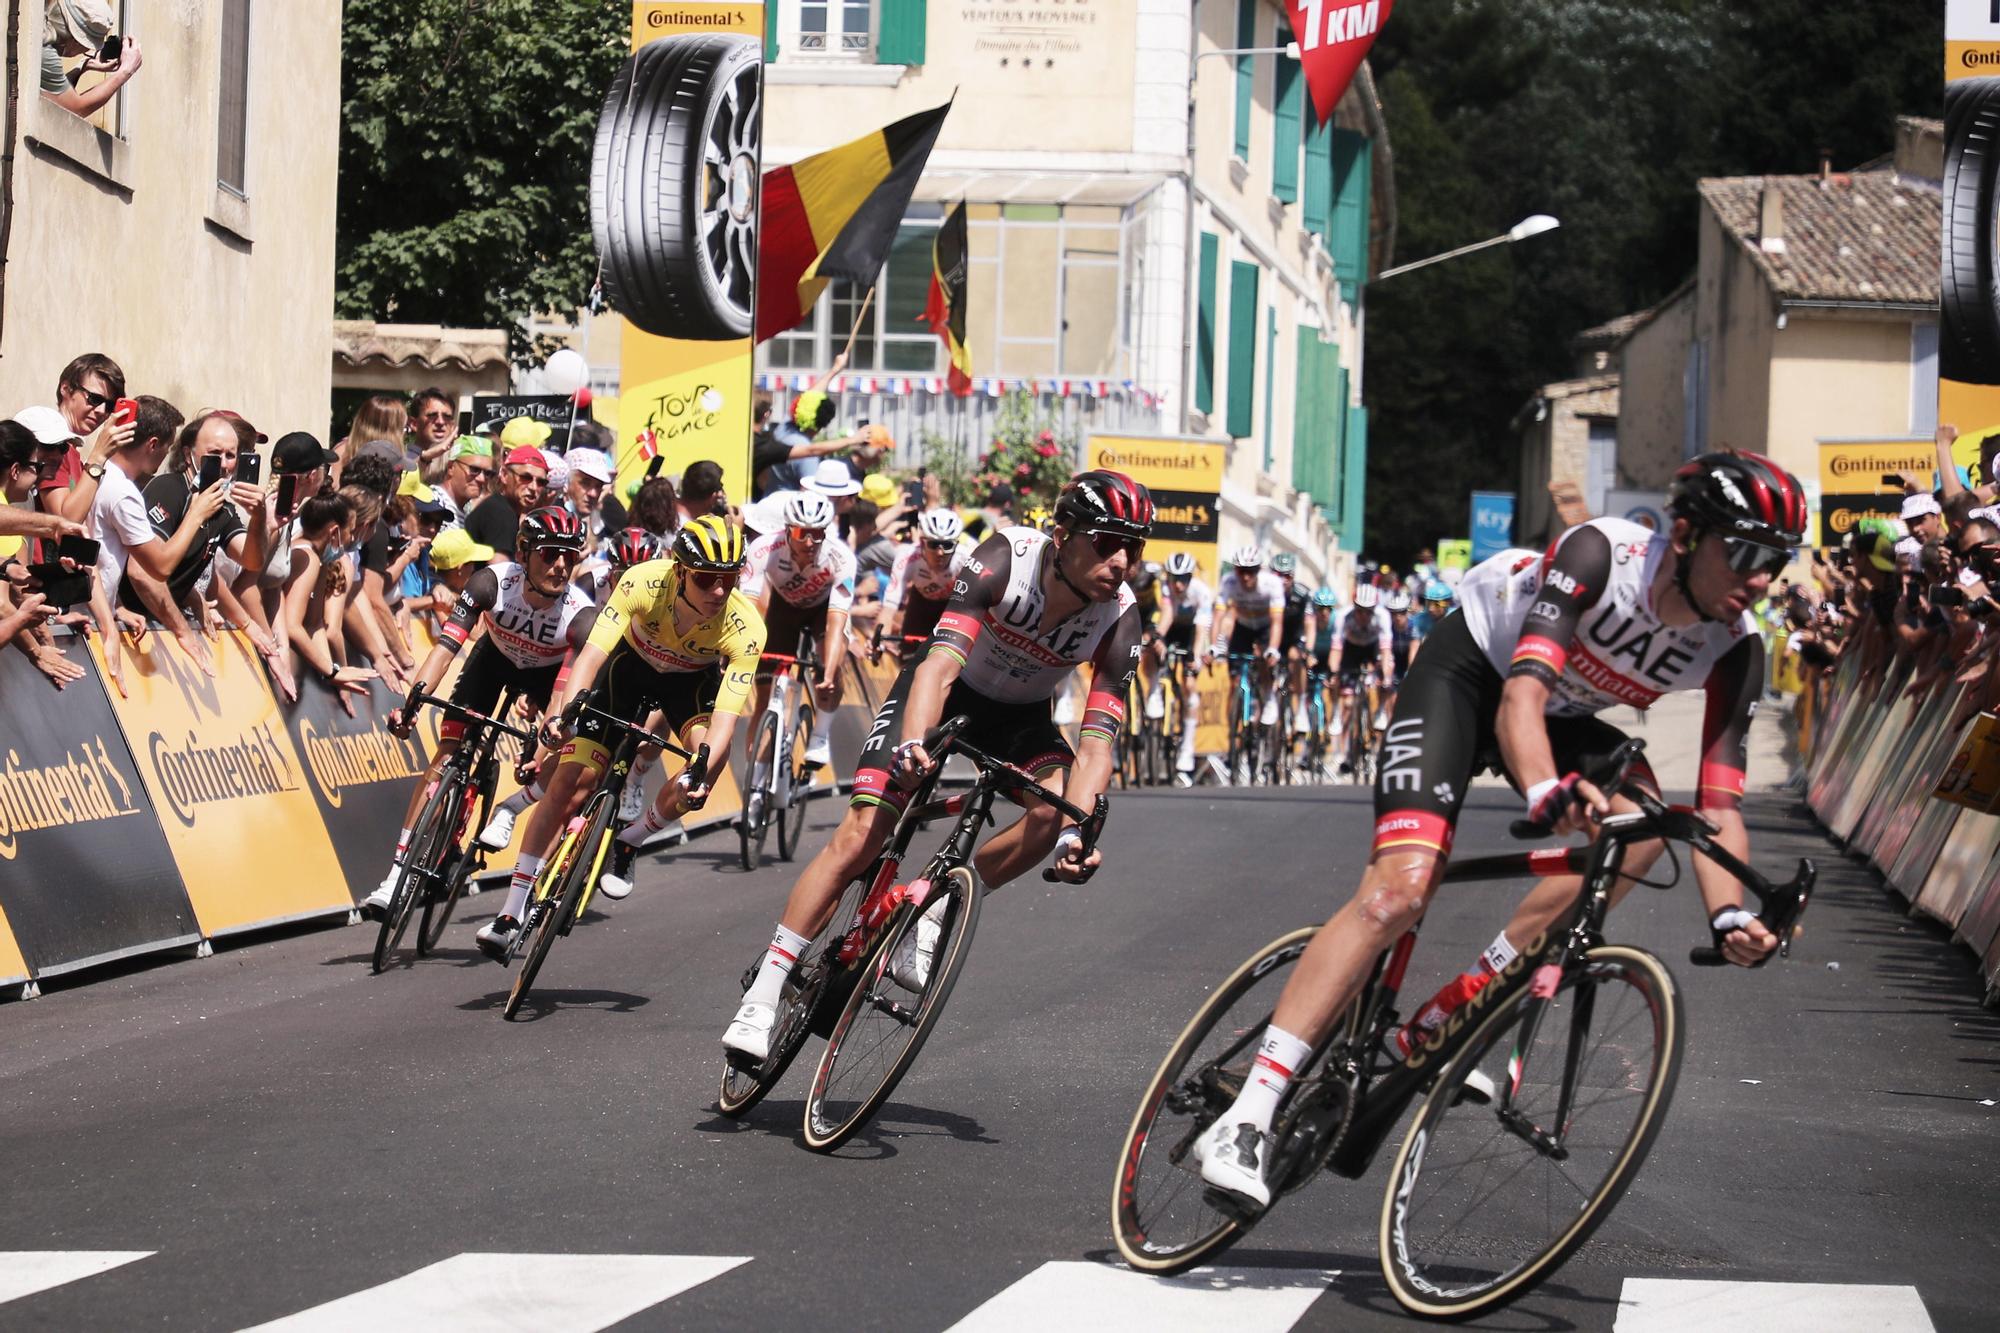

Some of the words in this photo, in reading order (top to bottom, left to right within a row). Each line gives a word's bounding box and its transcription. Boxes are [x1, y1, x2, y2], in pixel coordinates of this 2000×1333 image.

[647, 9, 732, 28] Continental
[1327, 0, 1379, 45] KM
[1098, 448, 1195, 469] Continental
[1830, 454, 1933, 477] Continental
[647, 578, 669, 590] LCL
[495, 611, 558, 646] UAE
[1588, 602, 1694, 687] UAE
[300, 713, 411, 810] Continental
[1382, 717, 1424, 794] UAE
[149, 725, 284, 829] Continental
